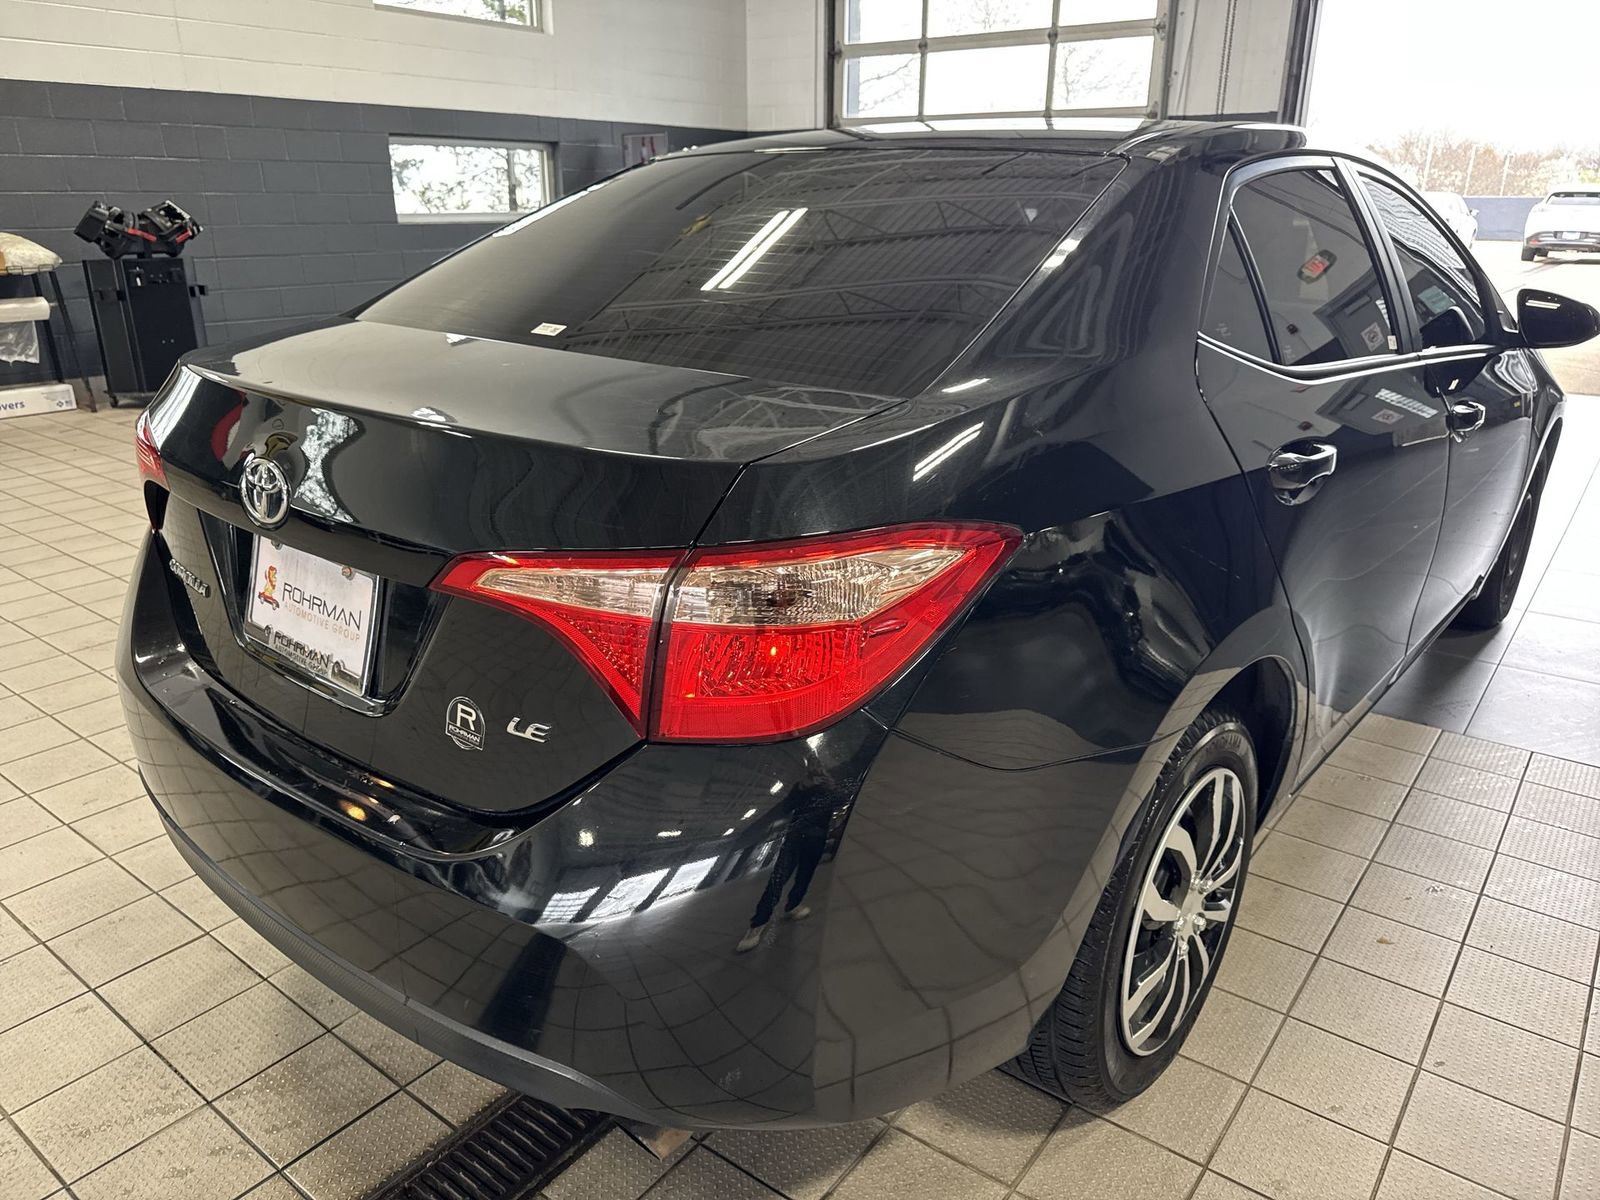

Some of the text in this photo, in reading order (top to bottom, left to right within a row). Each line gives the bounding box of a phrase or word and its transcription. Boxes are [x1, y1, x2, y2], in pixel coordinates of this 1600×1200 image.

[282, 582, 362, 631] ROHRMAN
[284, 602, 361, 641] AUTOMOTIVE GROUP
[273, 631, 330, 668] ROHRMAN
[456, 703, 476, 731] R
[506, 717, 552, 743] LE
